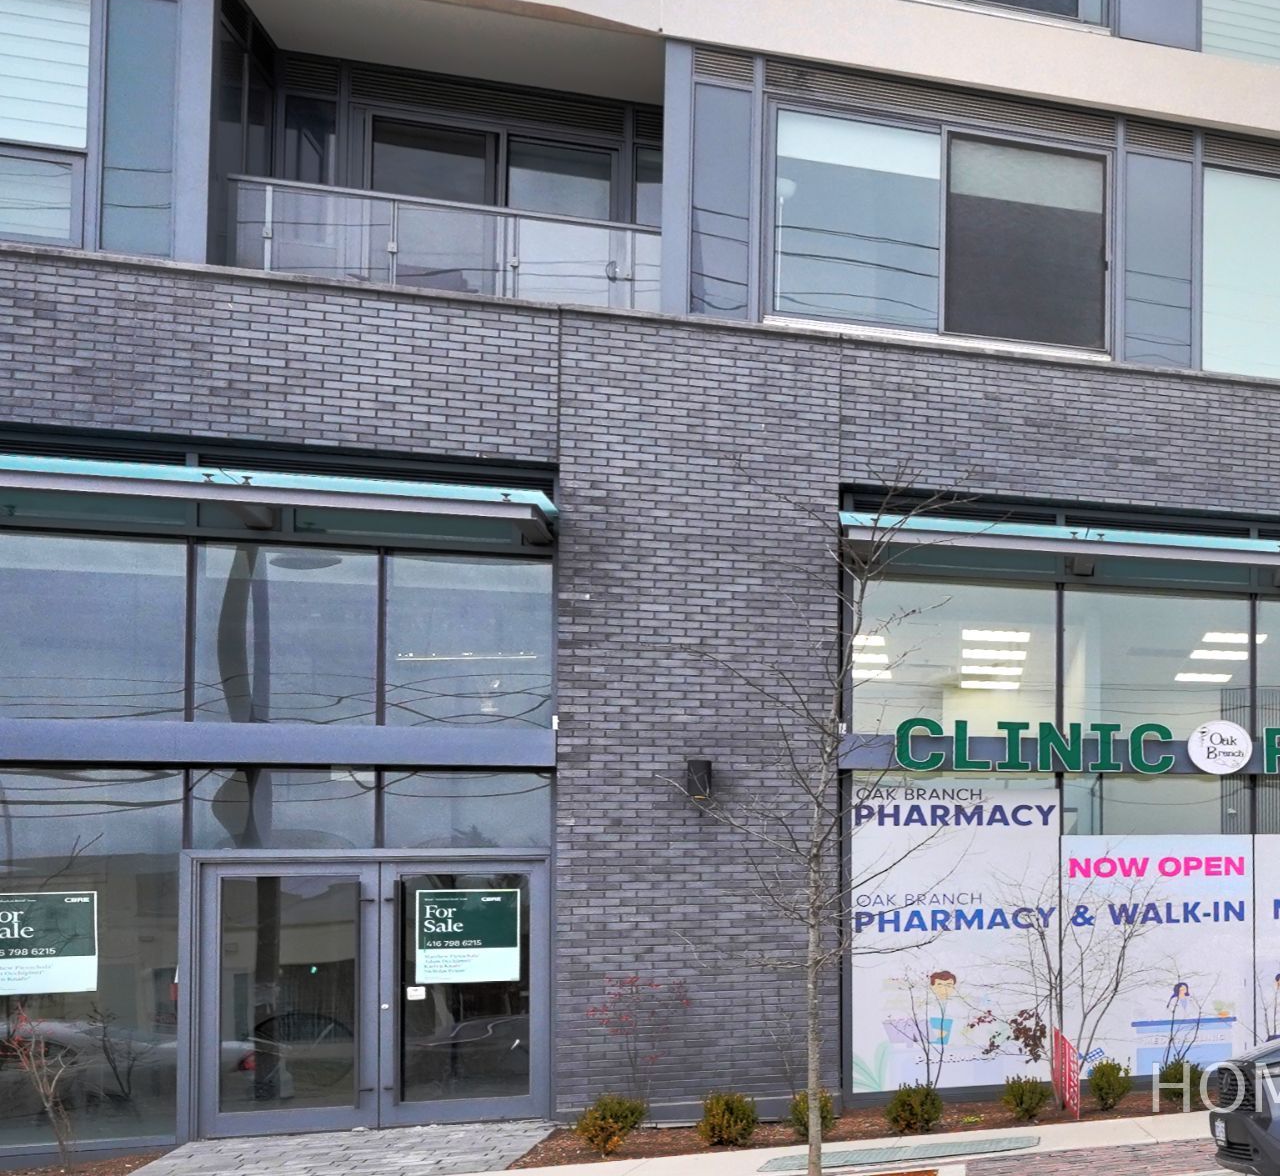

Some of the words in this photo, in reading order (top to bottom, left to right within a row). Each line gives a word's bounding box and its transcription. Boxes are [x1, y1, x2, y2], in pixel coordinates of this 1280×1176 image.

[895, 717, 1175, 774] CLINIC
[1209, 732, 1237, 746] Oak
[1206, 746, 1245, 759] Branch
[856, 788, 896, 801] OAK
[904, 788, 982, 801] BRANCH
[855, 804, 1056, 827] PHARMACY
[1069, 857, 1150, 878] NOW
[1158, 856, 1245, 876] OPEN
[856, 894, 896, 907] OAK
[904, 892, 982, 906] BRANCH
[0, 910, 24, 923] or
[424, 904, 456, 919] For
[855, 907, 1056, 933] PHARMACY
[1071, 905, 1095, 927] &
[1108, 900, 1245, 925] WALK-IN
[0, 923, 34, 939] ale
[423, 919, 464, 933] Sale
[8, 948, 28, 956] 798
[31, 947, 56, 955] 6215
